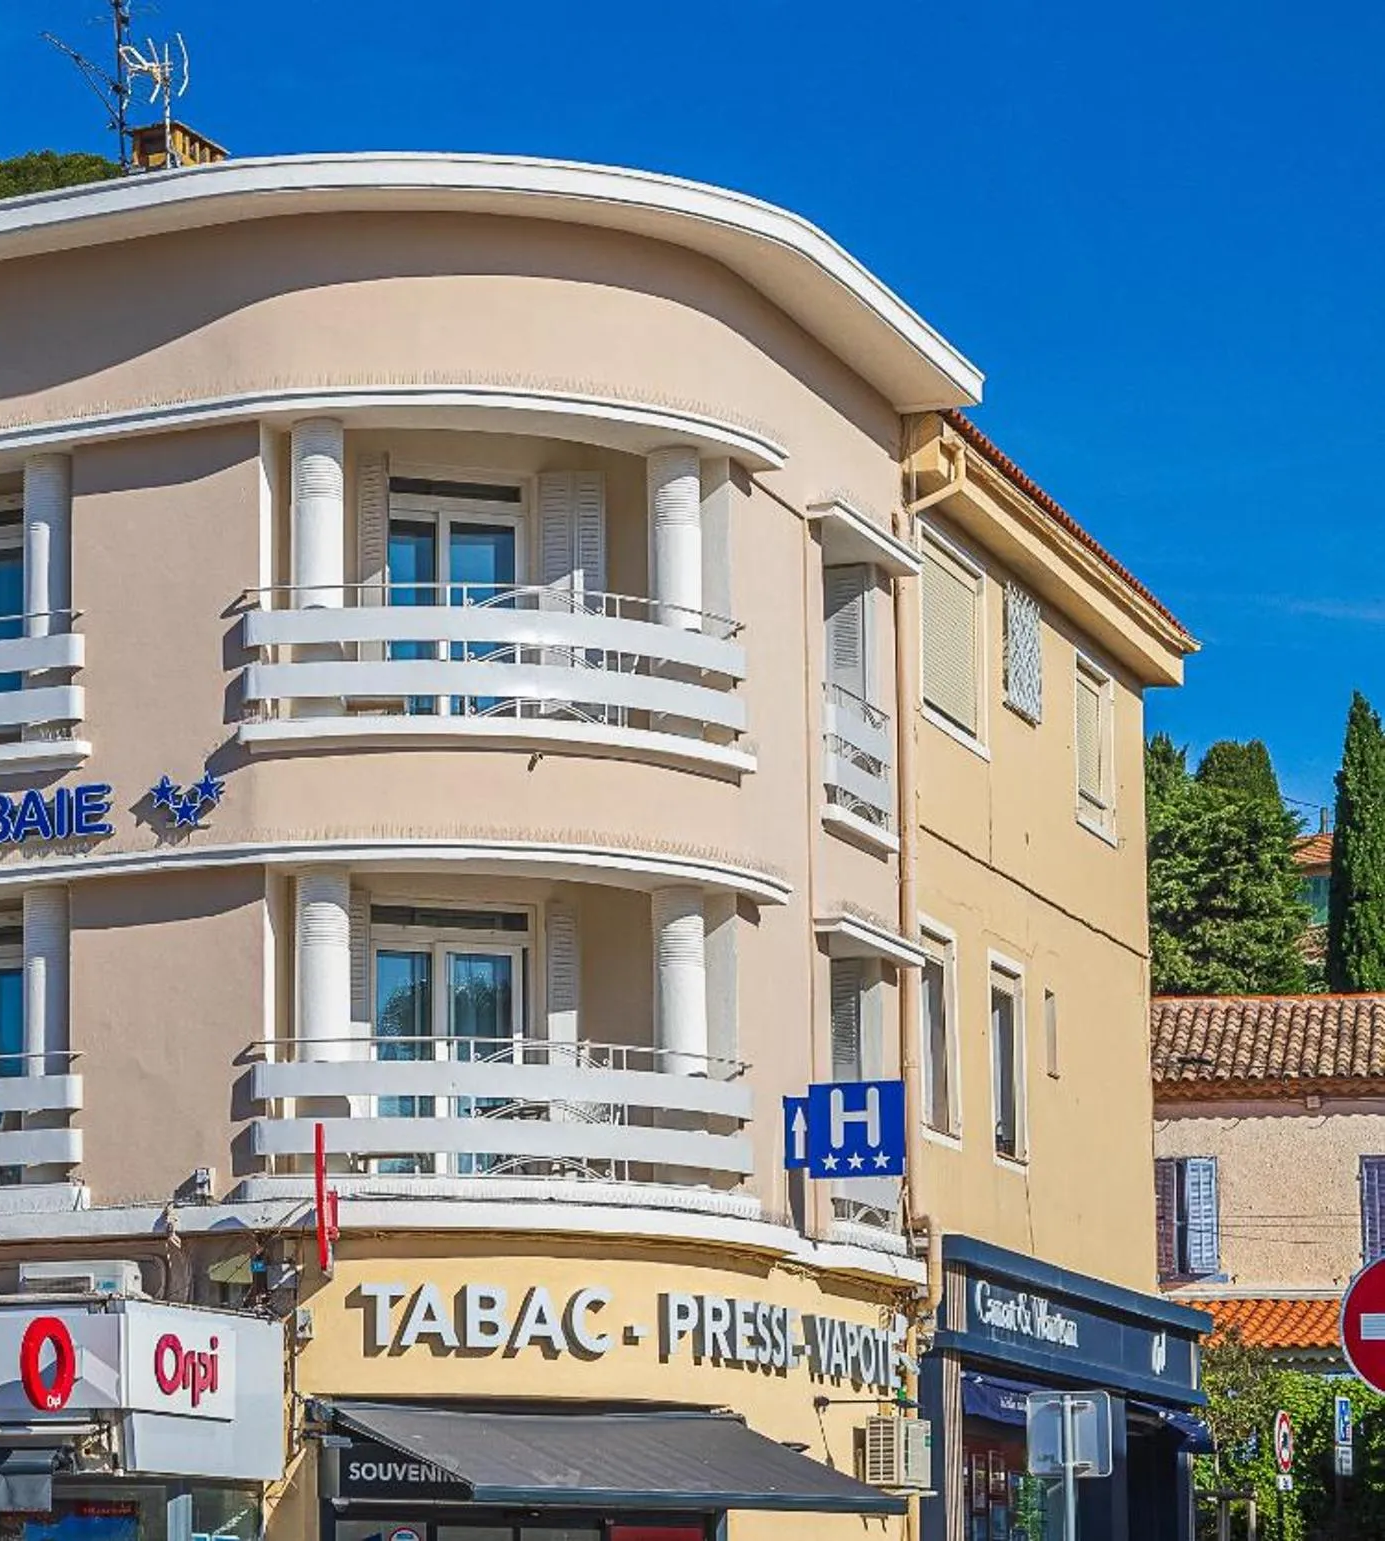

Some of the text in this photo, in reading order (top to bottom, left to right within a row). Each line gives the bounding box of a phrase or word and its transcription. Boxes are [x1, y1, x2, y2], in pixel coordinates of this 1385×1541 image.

[830, 1087, 880, 1149] H
[361, 1283, 614, 1354] TABAC
[668, 1291, 802, 1369] PRESSE
[154, 1333, 219, 1408] Orpi
[348, 1462, 464, 1484] SOUVENI
